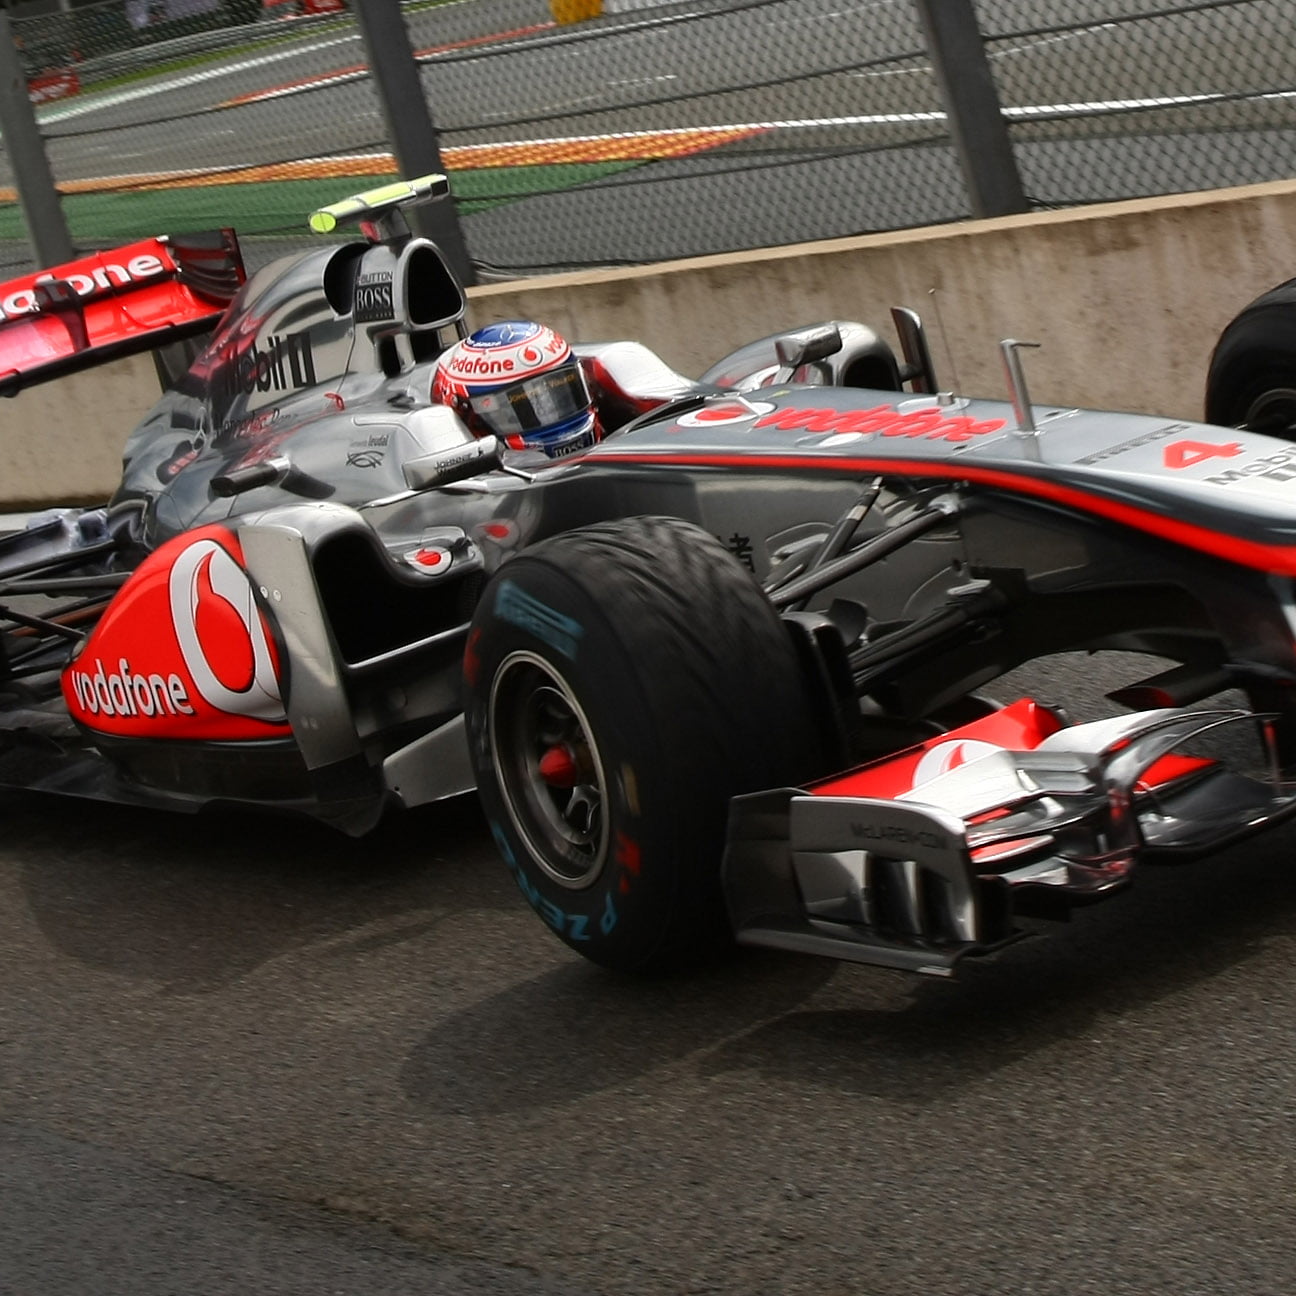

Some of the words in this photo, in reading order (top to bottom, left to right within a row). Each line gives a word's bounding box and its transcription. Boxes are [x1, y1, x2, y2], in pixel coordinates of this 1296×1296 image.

[356, 286, 391, 311] BOSS
[449, 356, 514, 375] vodafone
[1163, 439, 1247, 469] 4
[71, 658, 194, 716] vodafone
